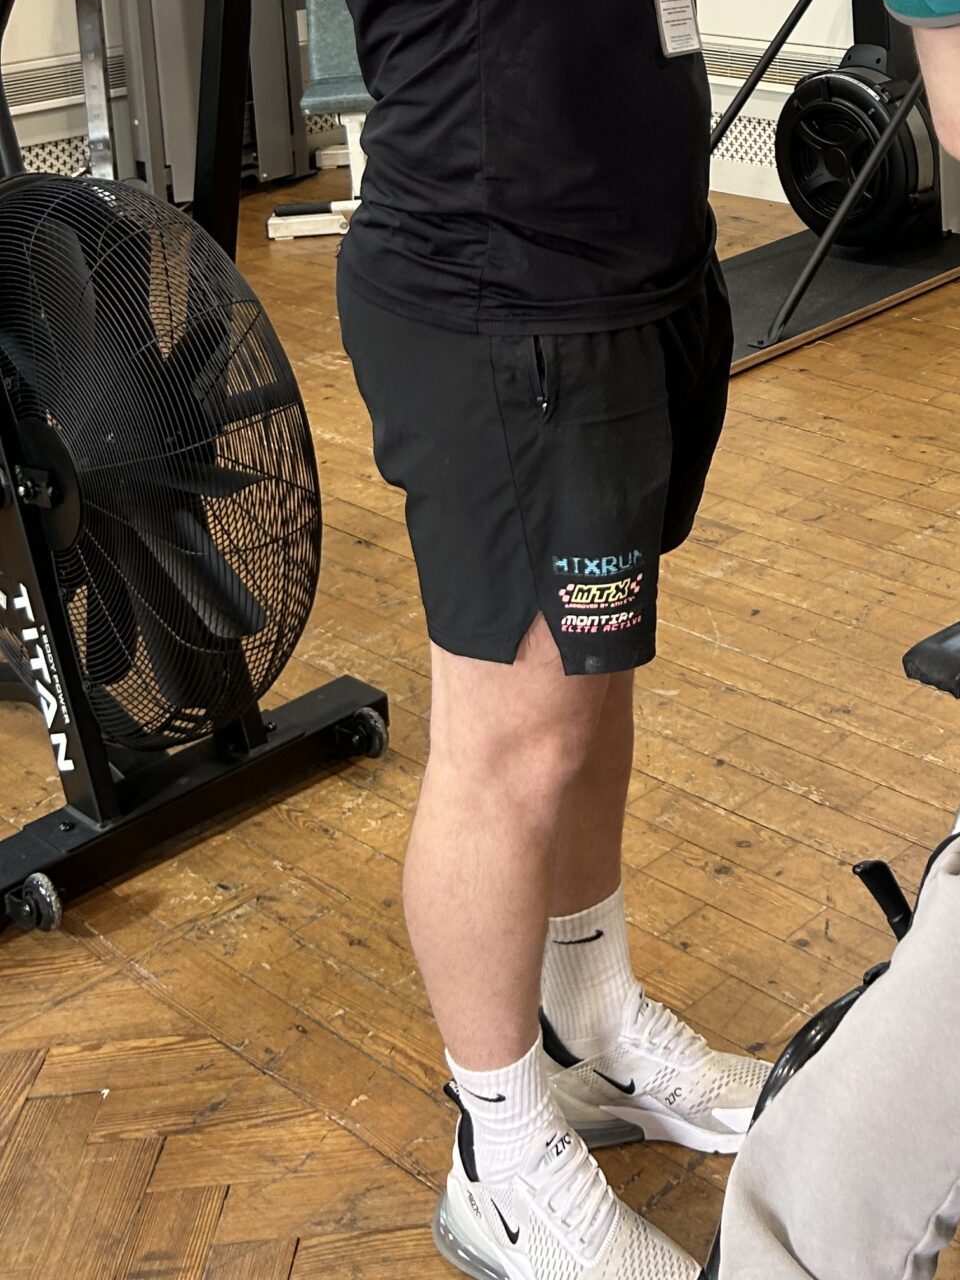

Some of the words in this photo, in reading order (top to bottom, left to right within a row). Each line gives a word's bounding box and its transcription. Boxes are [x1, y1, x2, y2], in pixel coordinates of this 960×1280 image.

[571, 578, 631, 603] MTX
[561, 612, 634, 626] MONTIR
[561, 624, 598, 633] ELITE
[13, 582, 75, 771] TITAN
[42, 634, 57, 672] BODY
[52, 674, 71, 725] POWER
